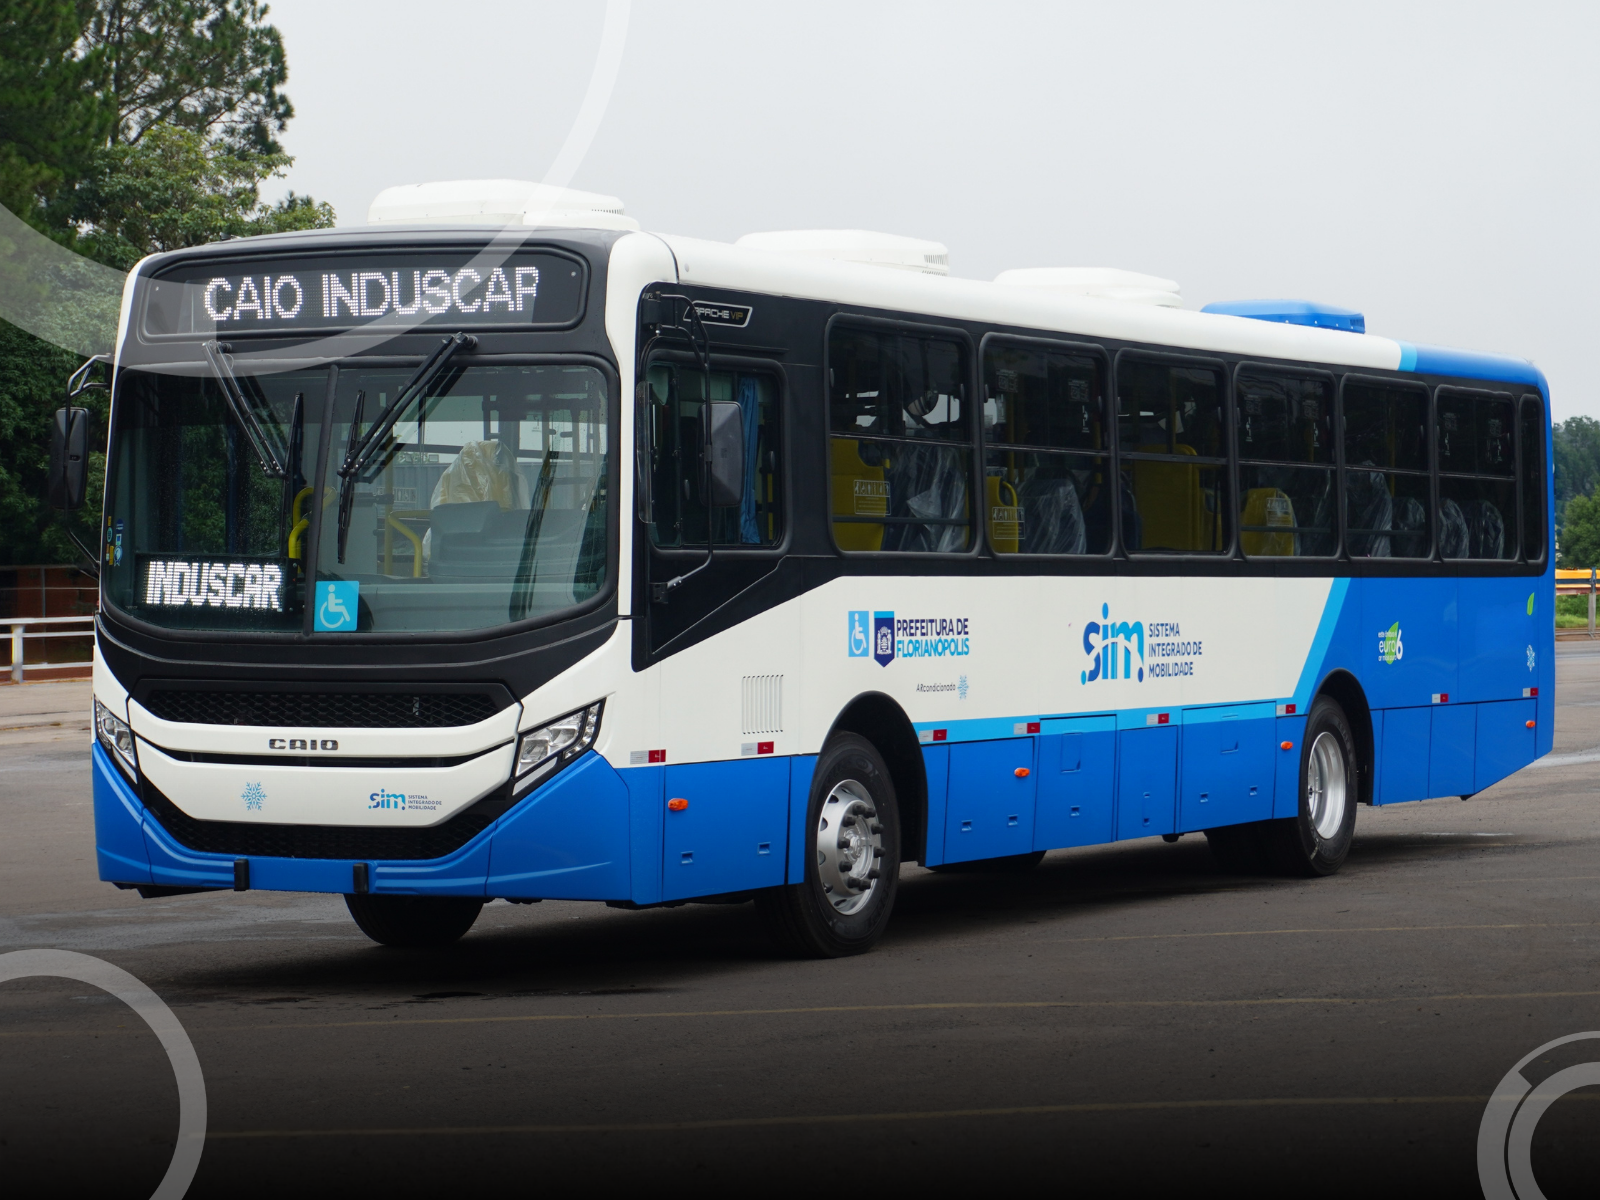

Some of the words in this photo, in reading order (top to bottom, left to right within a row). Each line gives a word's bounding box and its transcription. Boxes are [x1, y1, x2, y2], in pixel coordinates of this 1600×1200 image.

[204, 275, 303, 321] CAIO
[730, 311, 744, 320] VIP
[145, 561, 283, 609] INDUSCAR
[896, 618, 954, 637] PREFEITURA
[956, 618, 969, 636] DE
[1148, 622, 1180, 638] SISTEMA
[896, 637, 970, 658] FLORIANÓPOLIS
[1148, 641, 1192, 657] INTEGRADO
[1192, 641, 1203, 656] DE
[1148, 661, 1194, 678] MOBILIDADE
[268, 739, 339, 750] CAIO
